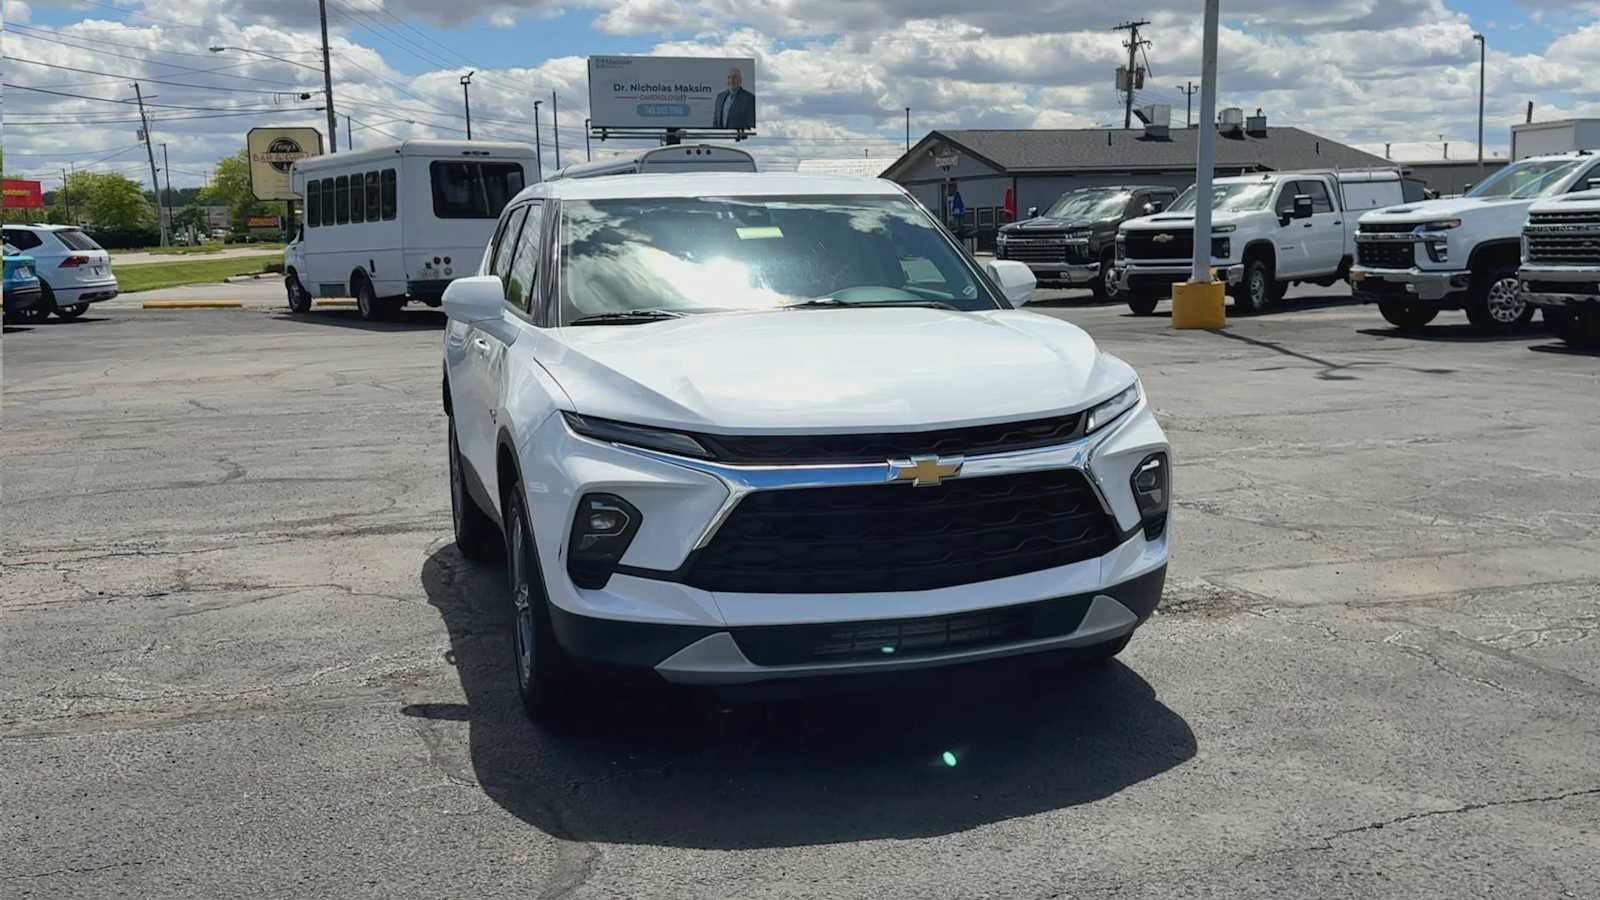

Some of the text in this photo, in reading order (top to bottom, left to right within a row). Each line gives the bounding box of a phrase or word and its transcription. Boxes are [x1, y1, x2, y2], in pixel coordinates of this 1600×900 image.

[613, 83, 712, 93] Dr. Nicholas Maksim
